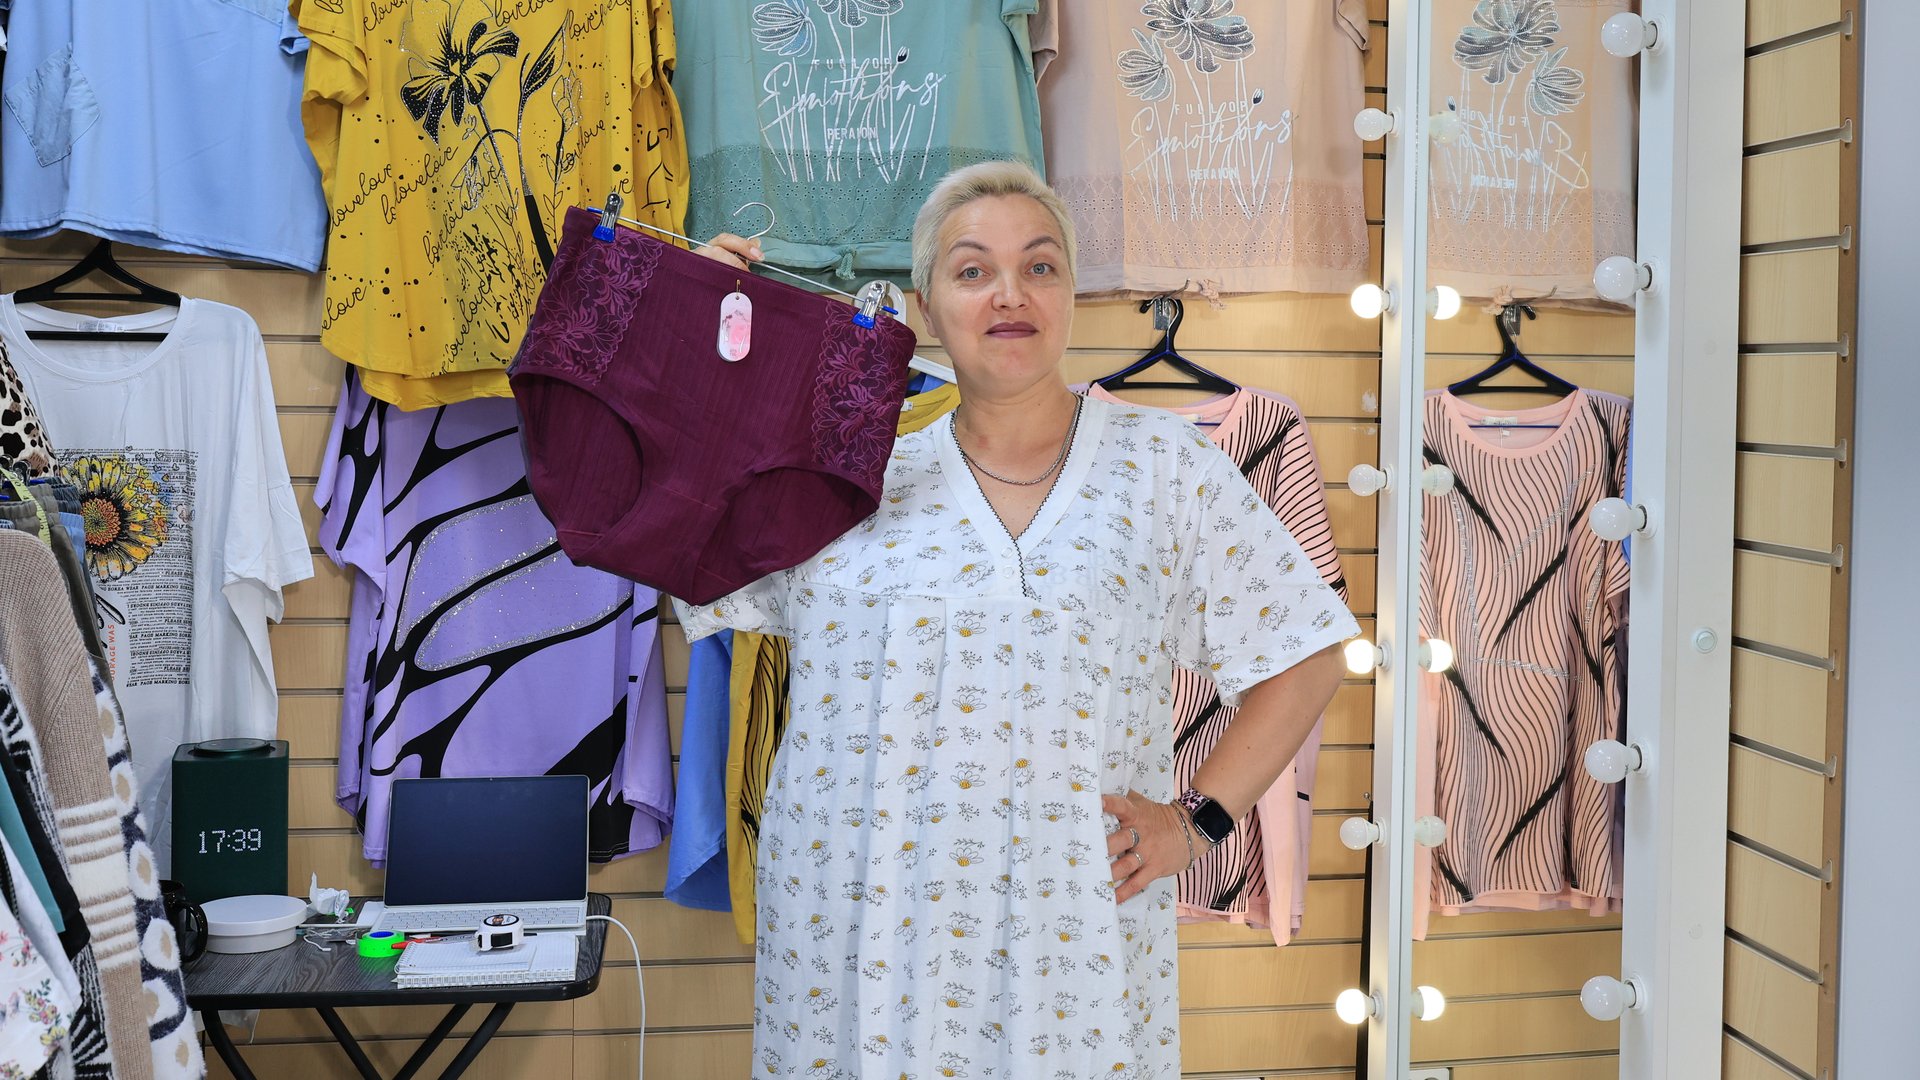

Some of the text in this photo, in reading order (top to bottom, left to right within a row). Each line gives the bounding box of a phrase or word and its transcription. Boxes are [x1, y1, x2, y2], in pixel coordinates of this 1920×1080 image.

[812, 57, 860, 71] FULL
[1173, 102, 1217, 116] FULL
[107, 623, 116, 643] WAS
[199, 828, 262, 854] 17:39
